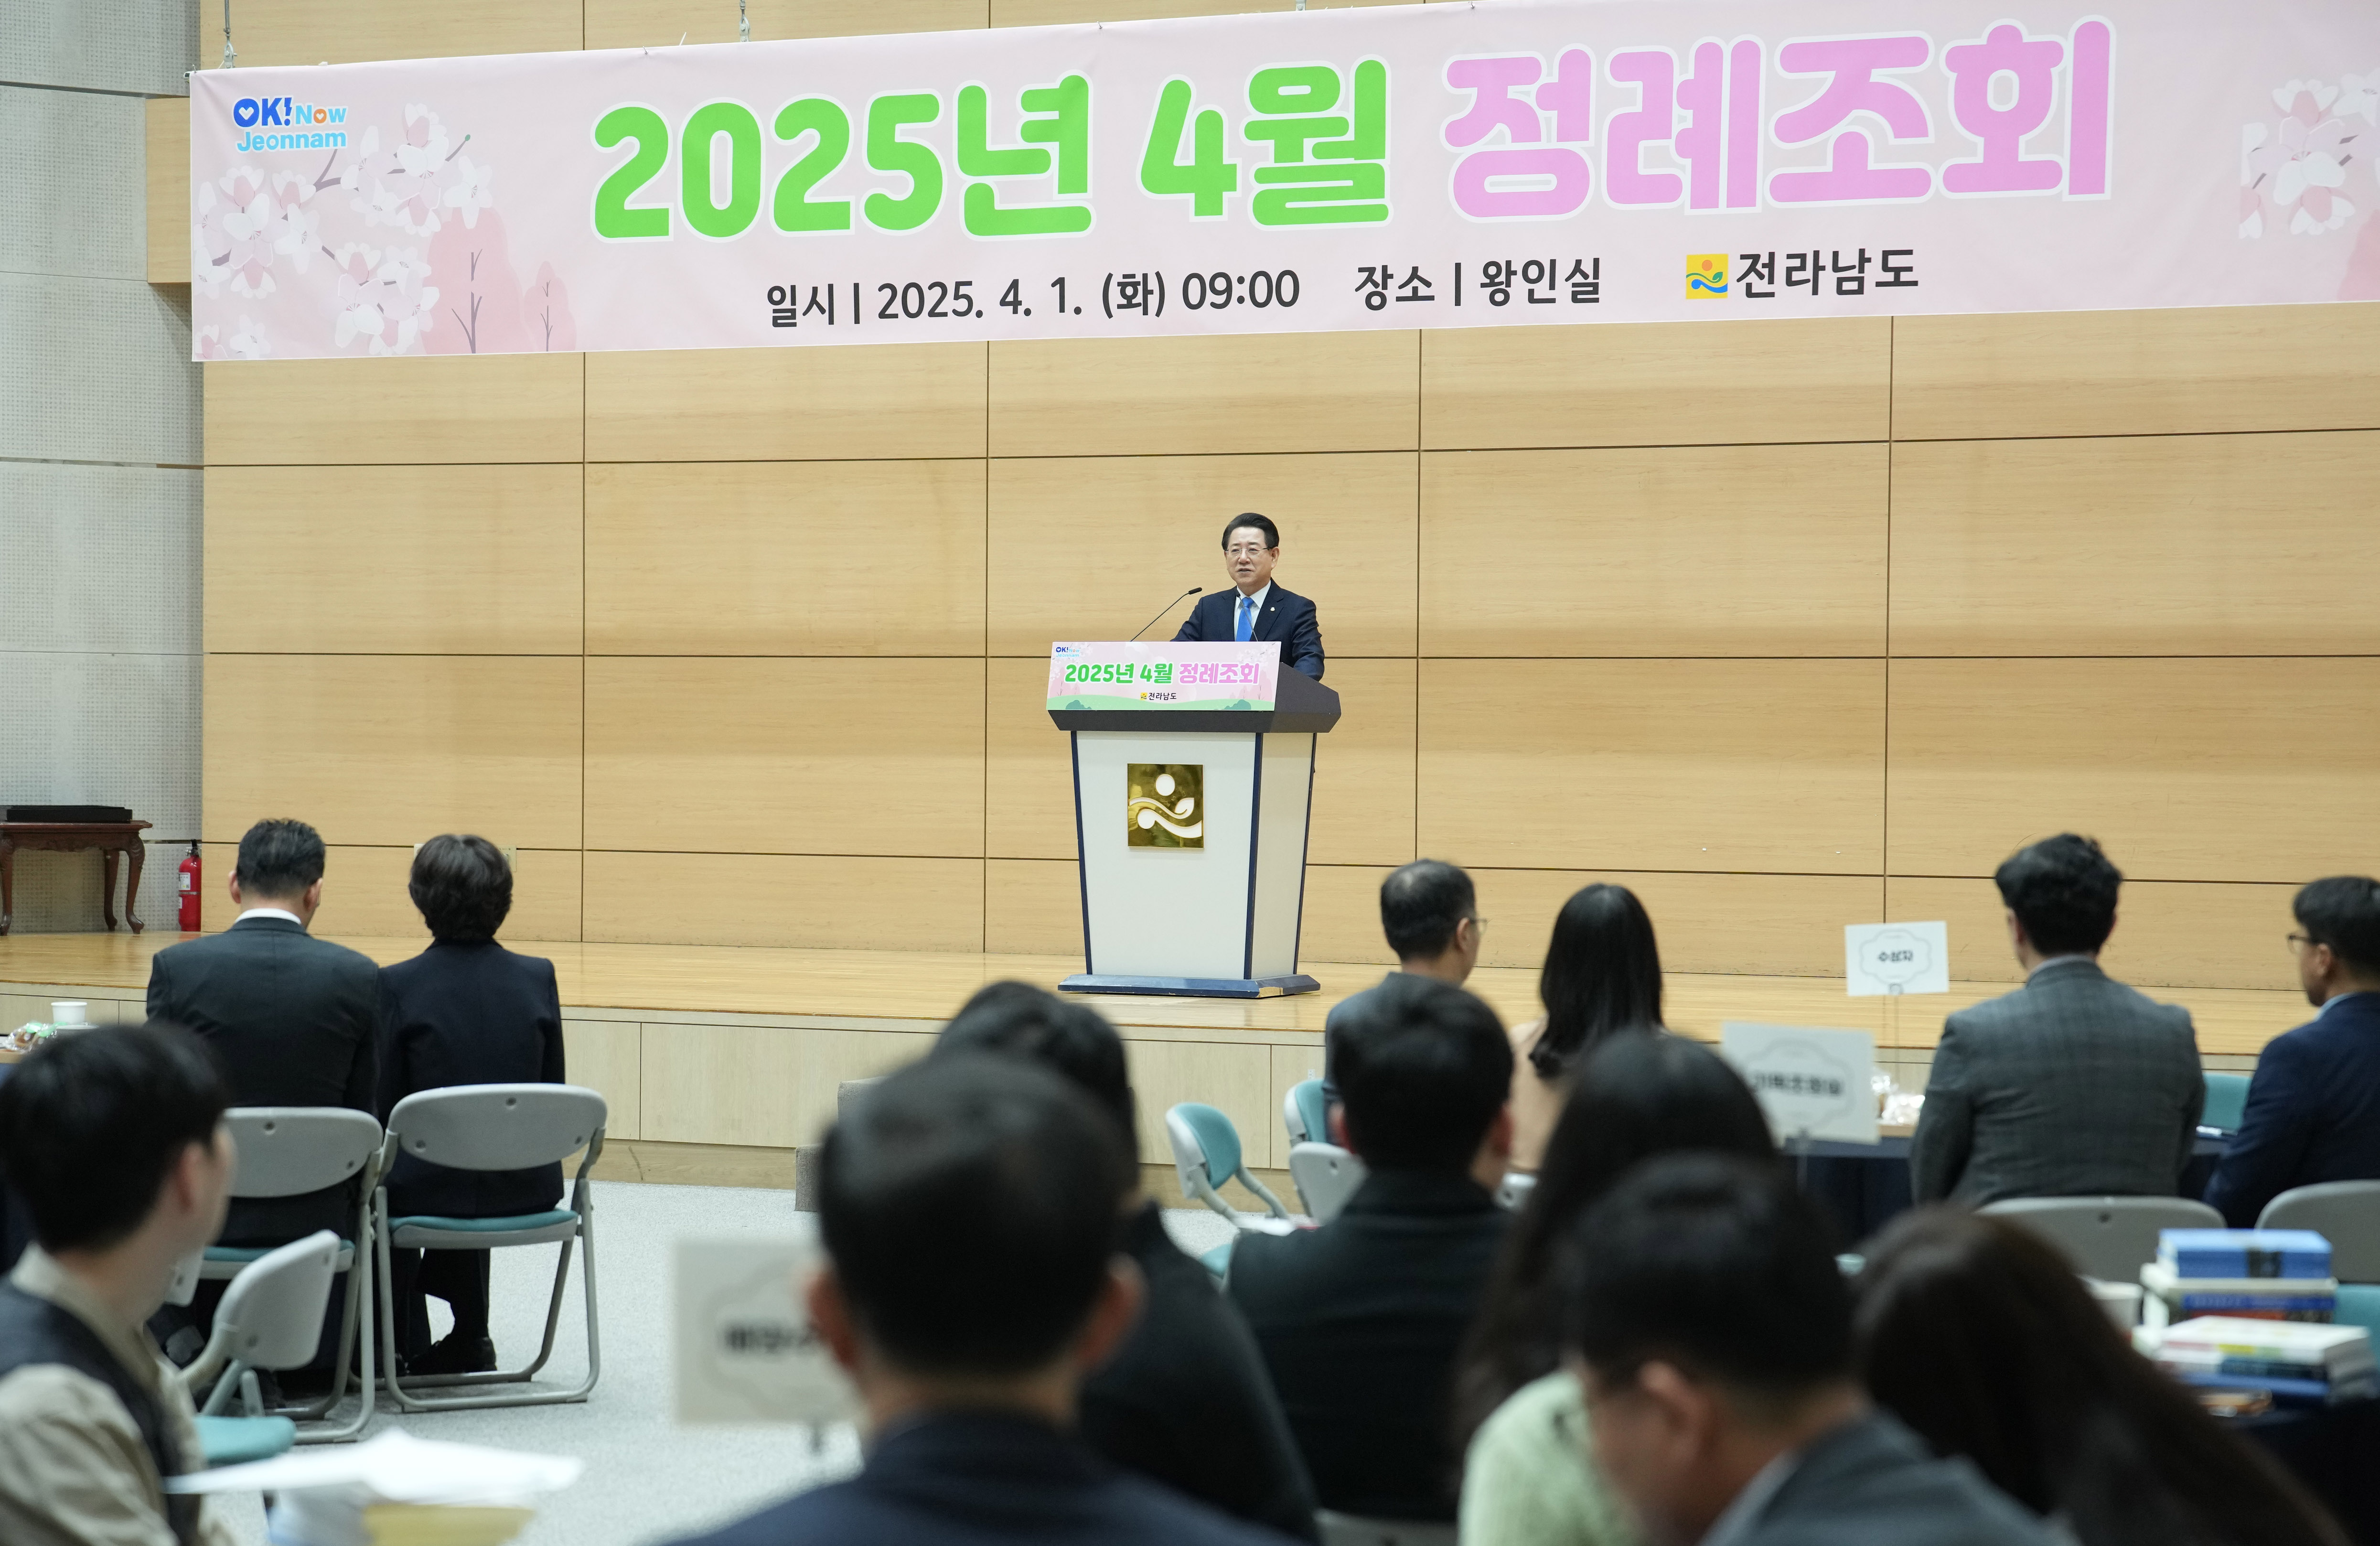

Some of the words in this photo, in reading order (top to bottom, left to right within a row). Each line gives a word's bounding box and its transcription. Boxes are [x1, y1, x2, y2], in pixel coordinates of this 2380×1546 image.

[233, 97, 292, 127] OK!
[296, 105, 346, 125] Now
[594, 75, 1092, 238] 2025년
[1141, 59, 1389, 226] 4월
[1445, 21, 2111, 218] 정례조회
[237, 131, 346, 152] Jeonnam
[1354, 265, 1435, 311] 장소
[1480, 257, 1600, 307] 왕인실
[1736, 248, 1919, 298] 전라남도
[767, 283, 835, 328] 일시
[877, 280, 983, 319] 2025.
[999, 279, 1031, 317] 4.
[1051, 277, 1082, 315] 1.
[1102, 271, 1165, 319] (화)
[1182, 269, 1300, 311] 09:00
[1065, 663, 1134, 684] 2025년
[1140, 663, 1173, 684] 4월
[1179, 663, 1260, 684] 정례조회
[1148, 692, 1177, 700] 전라남도
